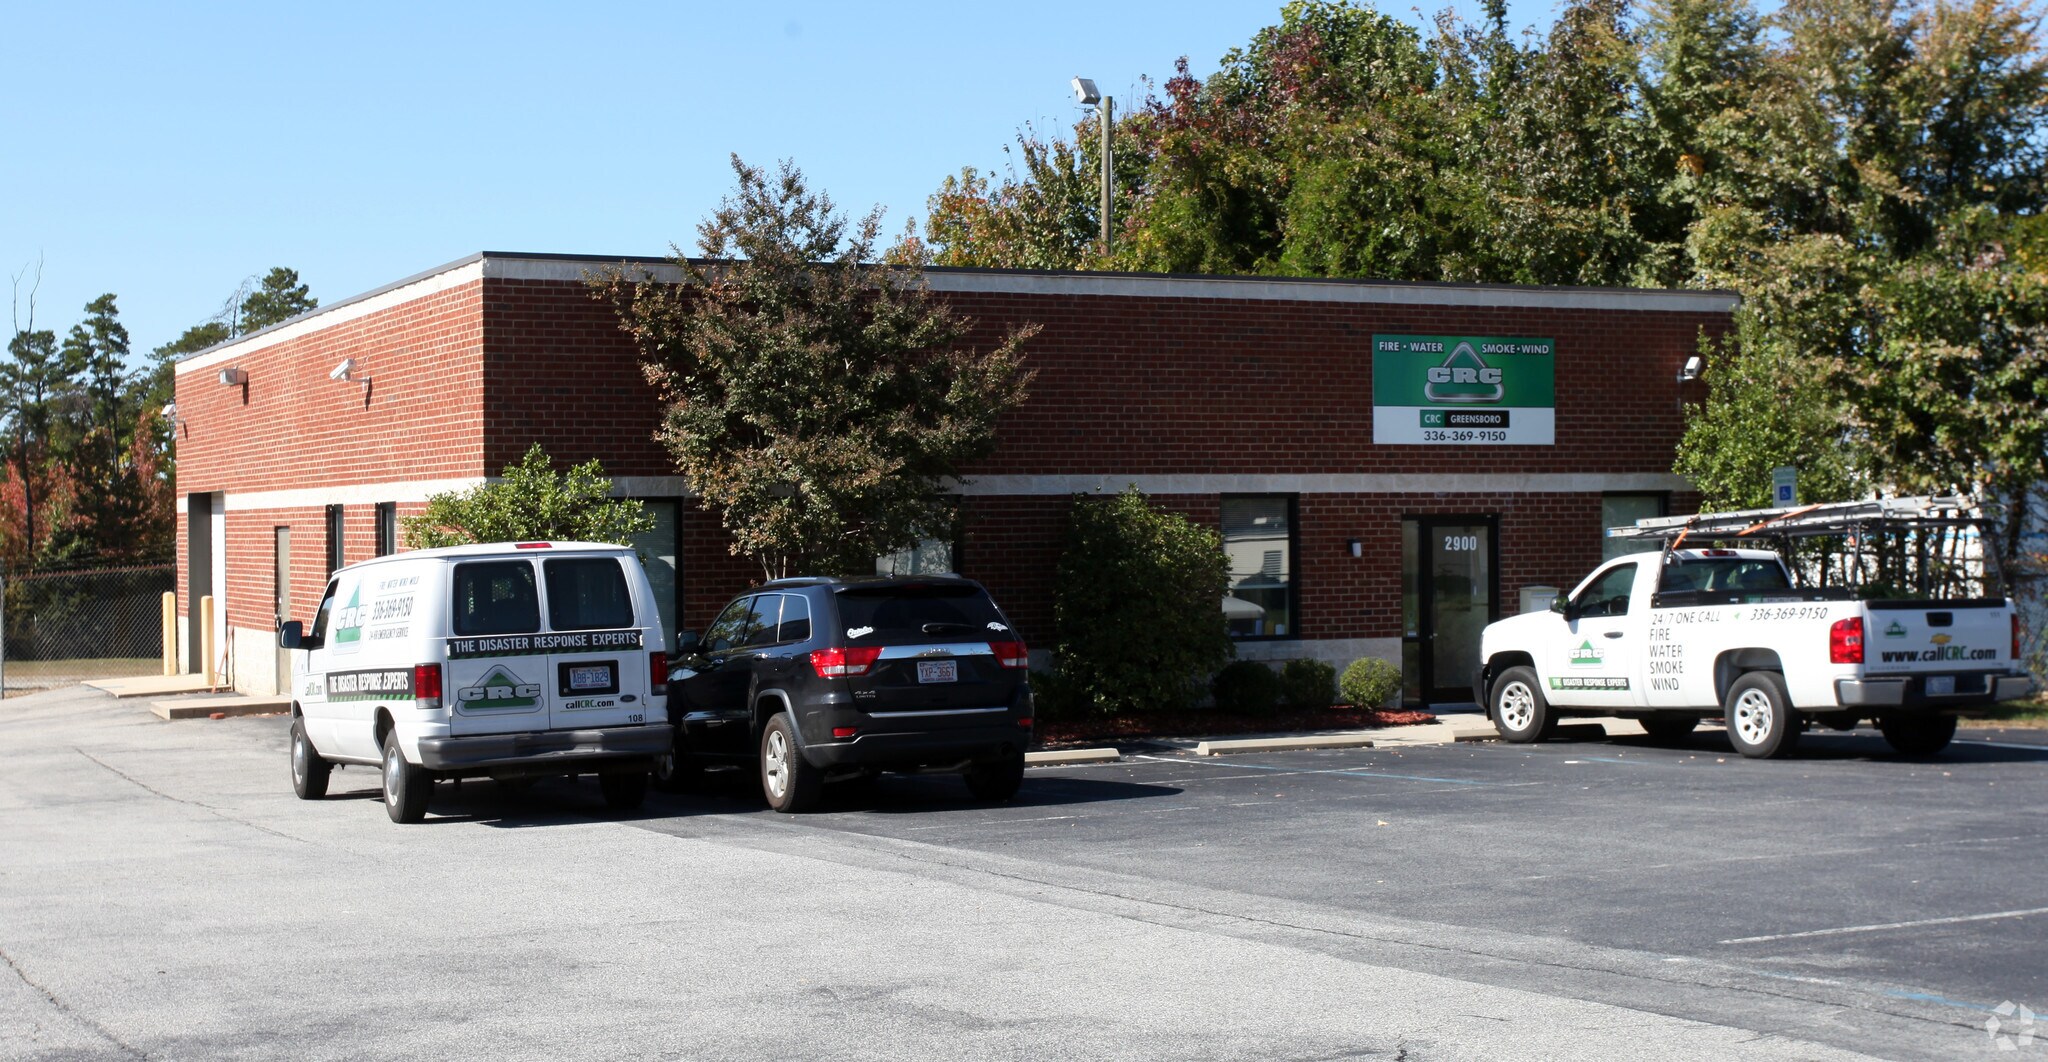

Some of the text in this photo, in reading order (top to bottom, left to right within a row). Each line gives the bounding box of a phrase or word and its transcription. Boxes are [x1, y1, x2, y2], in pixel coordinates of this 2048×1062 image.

[1379, 341, 1443, 353] FIRE WATER
[1482, 344, 1549, 354] SMOKE WIND
[1427, 367, 1502, 383] CRC
[1424, 414, 1501, 424] CRC GREENSBORO
[1424, 431, 1506, 441] 336-369-9150
[1444, 536, 1477, 551] 2900
[372, 596, 414, 621] 336-369-9150
[1749, 607, 1828, 621] 336-369-9150
[336, 604, 368, 631] CRC
[1652, 611, 1721, 625] 24/7 ONE CALL
[1649, 628, 1670, 641] FIRE
[454, 632, 637, 653] THE DISASTER RESPONSE EXPERTS
[1568, 648, 1604, 659] CRC
[1649, 645, 1683, 658] WATER
[1882, 645, 1996, 662] www.callCRC.com
[1649, 660, 1683, 674] SMOKE
[329, 671, 409, 693] THE DISASTER RESPONSE EXPERTS
[1606, 678, 1628, 687] EXPERTS
[1651, 678, 1679, 691] WIND
[458, 684, 541, 701] CRC
[565, 700, 615, 709] callCRC.com
[628, 714, 643, 722] 108
